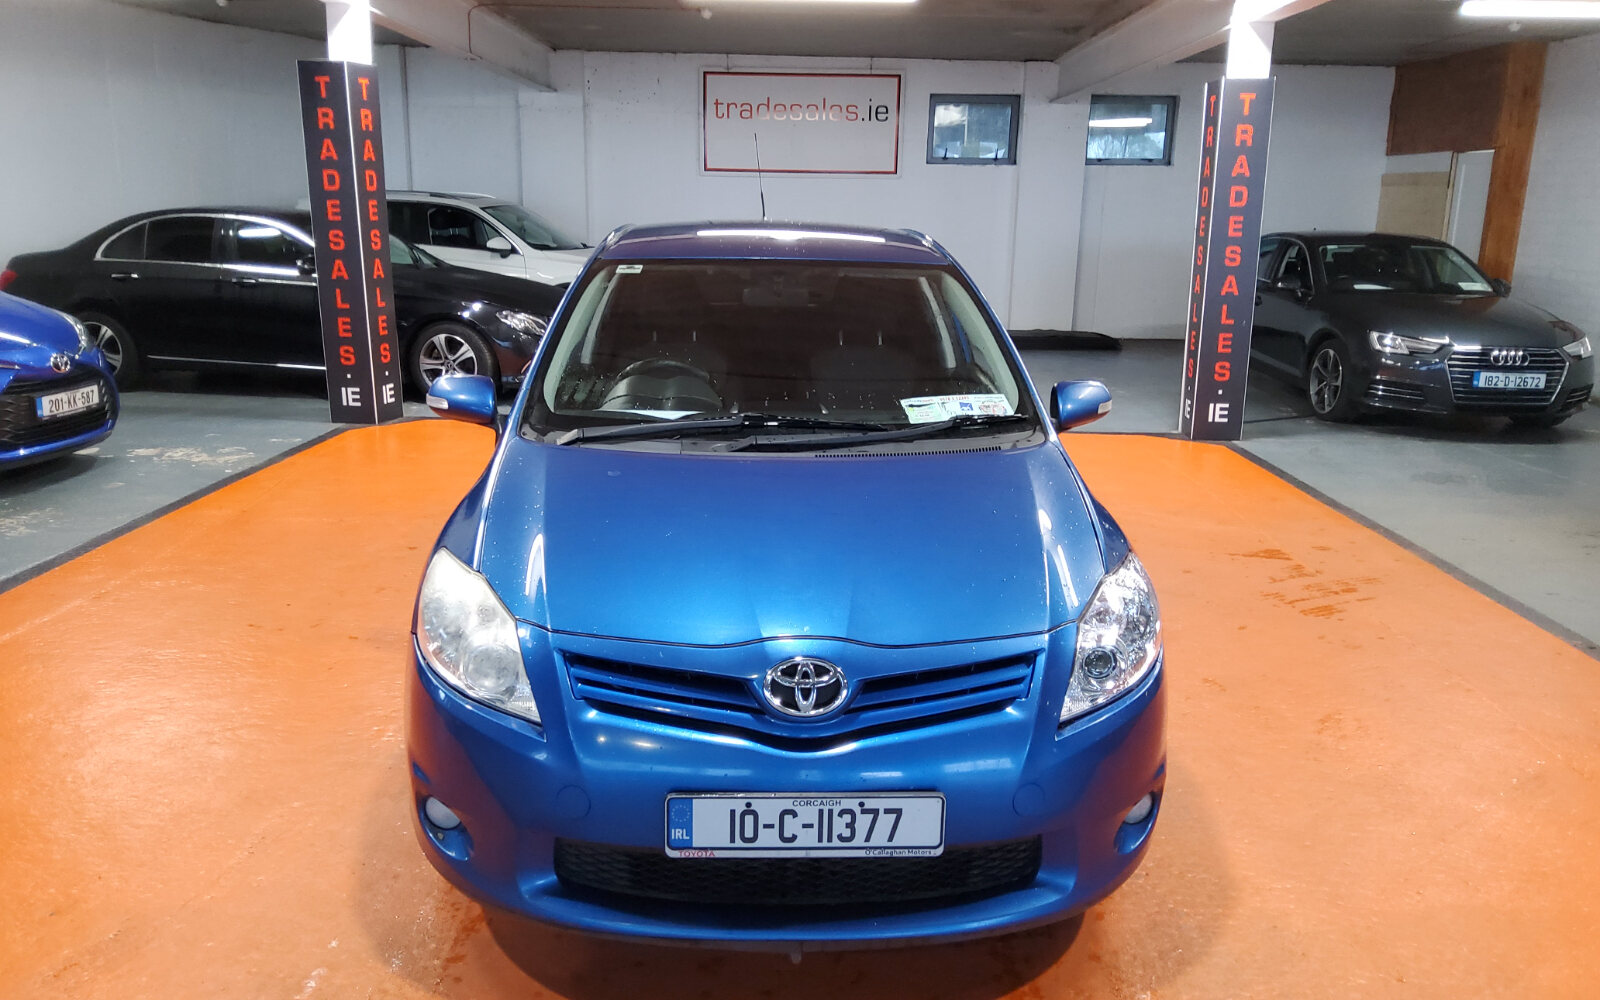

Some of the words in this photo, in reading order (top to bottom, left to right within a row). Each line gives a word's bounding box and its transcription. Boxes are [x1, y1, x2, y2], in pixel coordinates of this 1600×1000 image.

[713, 96, 889, 122] tradesales.ie
[1484, 375, 1542, 388] 182-D-12672
[48, 389, 95, 414] 201-KK-587
[792, 799, 842, 807] CORCAIGH
[729, 807, 904, 844] 10-C-11377
[671, 828, 690, 840] IRL
[864, 848, 907, 857] O'Callaghan
